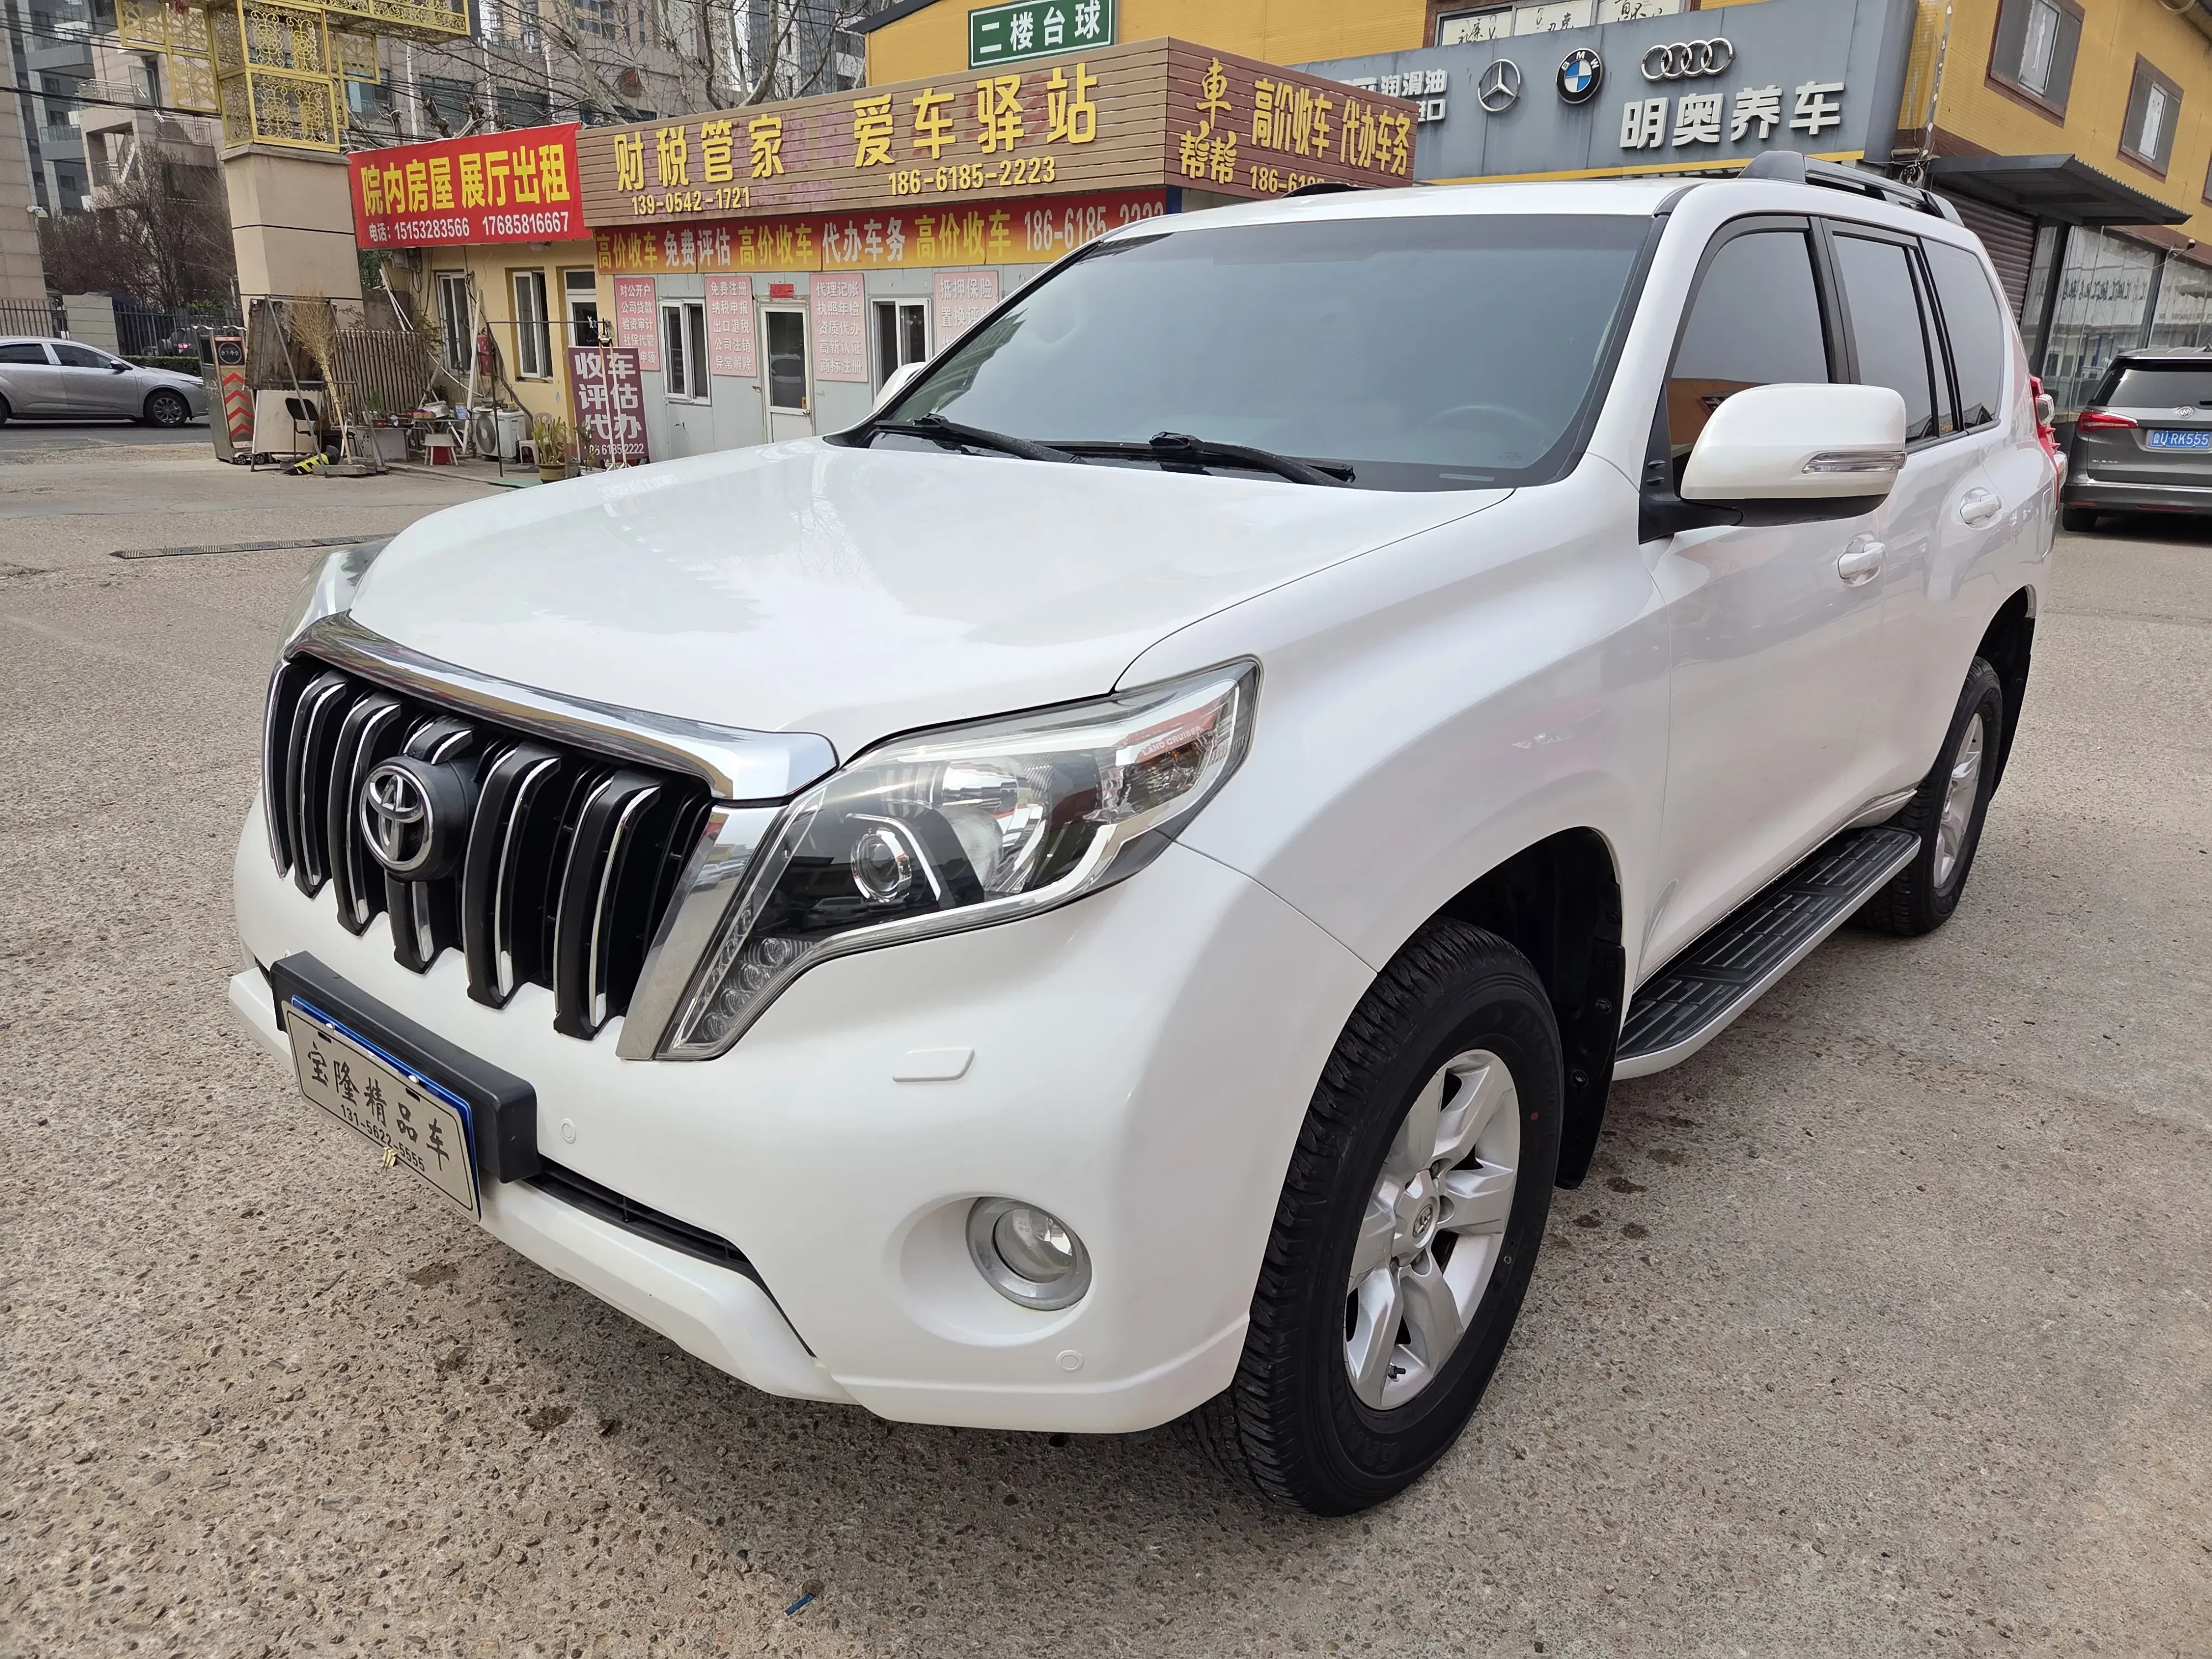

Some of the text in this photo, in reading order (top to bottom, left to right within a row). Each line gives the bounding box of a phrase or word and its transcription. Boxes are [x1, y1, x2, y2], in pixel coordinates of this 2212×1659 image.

[980, 0, 1100, 54] 二楼台球
[1561, 51, 1599, 71] BMW
[1338, 69, 1448, 98] 润滑油
[853, 63, 1098, 167] 爱车驿站
[1251, 78, 1409, 176] 高价收车 代办车务
[1620, 81, 1845, 149] 明奥养车
[614, 114, 784, 192] 财税管家
[1178, 121, 1237, 184] 帮帮
[361, 144, 570, 216] 院内房屋 展厅出租
[889, 156, 1056, 196] 186-6185-2223
[632, 186, 750, 216] 139-0542-1721
[482, 211, 569, 236] 17685816667
[597, 231, 658, 269] 高价收车
[664, 227, 731, 268] 免费评估
[738, 223, 813, 265] 高价收车
[822, 217, 906, 264] 代办车务
[915, 208, 1011, 261] 高价收车
[619, 284, 650, 298] 对公开户
[711, 281, 747, 296] 免费注册
[940, 277, 993, 301] 抵押保险
[622, 301, 653, 314] 公司贷款
[712, 300, 749, 315] 纳税申报
[817, 300, 860, 317] 执照年检
[622, 317, 654, 331] 验资审计
[713, 319, 750, 335] 出口退税
[818, 320, 860, 336] 资质代办
[623, 333, 655, 347] 社保代管
[714, 338, 750, 353] 公司注销
[820, 340, 862, 356] 高新认证
[640, 351, 656, 364] 申领
[821, 358, 863, 375] 商标注册
[1141, 726, 1203, 756] LAND CRUISER
[307, 1041, 450, 1171] 宝隆精品车
[341, 1104, 425, 1172] 131-5622-5555
